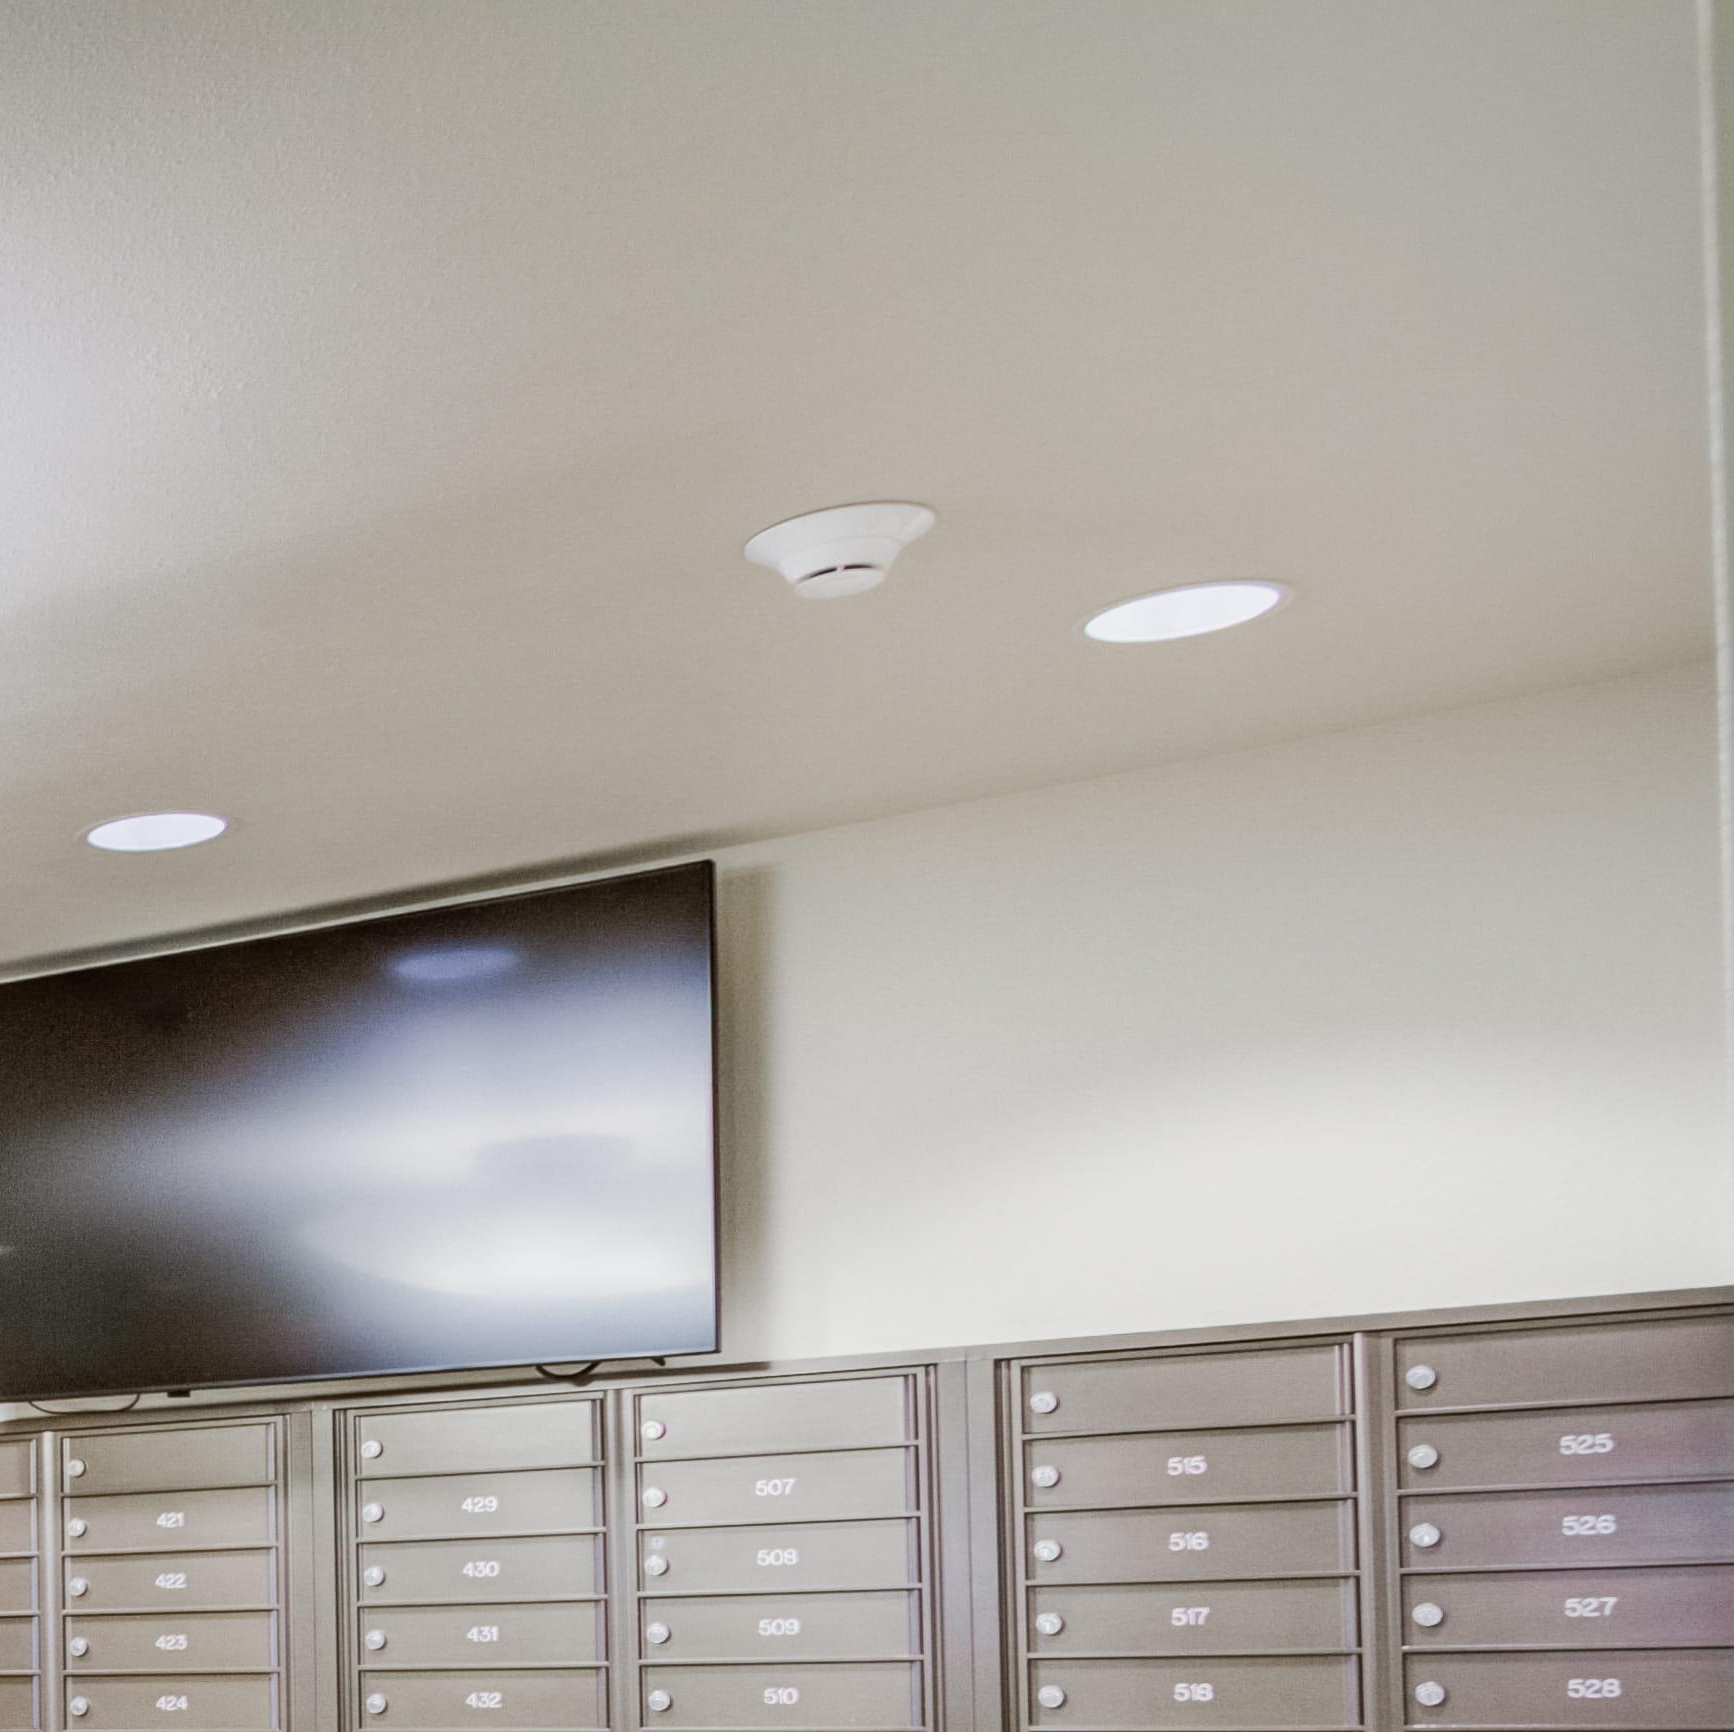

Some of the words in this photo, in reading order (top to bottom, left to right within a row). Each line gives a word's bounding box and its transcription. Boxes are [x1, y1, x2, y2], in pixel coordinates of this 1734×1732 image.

[1559, 1433, 1614, 1455] 525
[1167, 1455, 1207, 1476] 515
[755, 1477, 796, 1497] 507
[461, 1495, 499, 1513] 429
[156, 1512, 184, 1529] 421
[1561, 1514, 1617, 1536] 526
[1168, 1531, 1209, 1552] 516
[756, 1548, 799, 1567] 508
[462, 1560, 501, 1578] 430
[154, 1572, 187, 1589] 422
[1171, 1606, 1211, 1626] 517
[1564, 1596, 1618, 1618] 527
[466, 1625, 499, 1643] 431
[758, 1618, 800, 1636] 509
[155, 1634, 188, 1651] 423
[763, 1687, 799, 1705] 510
[1173, 1682, 1214, 1702] 518
[1567, 1678, 1622, 1699] 528
[155, 1695, 189, 1712] 424
[465, 1691, 502, 1709] 432
